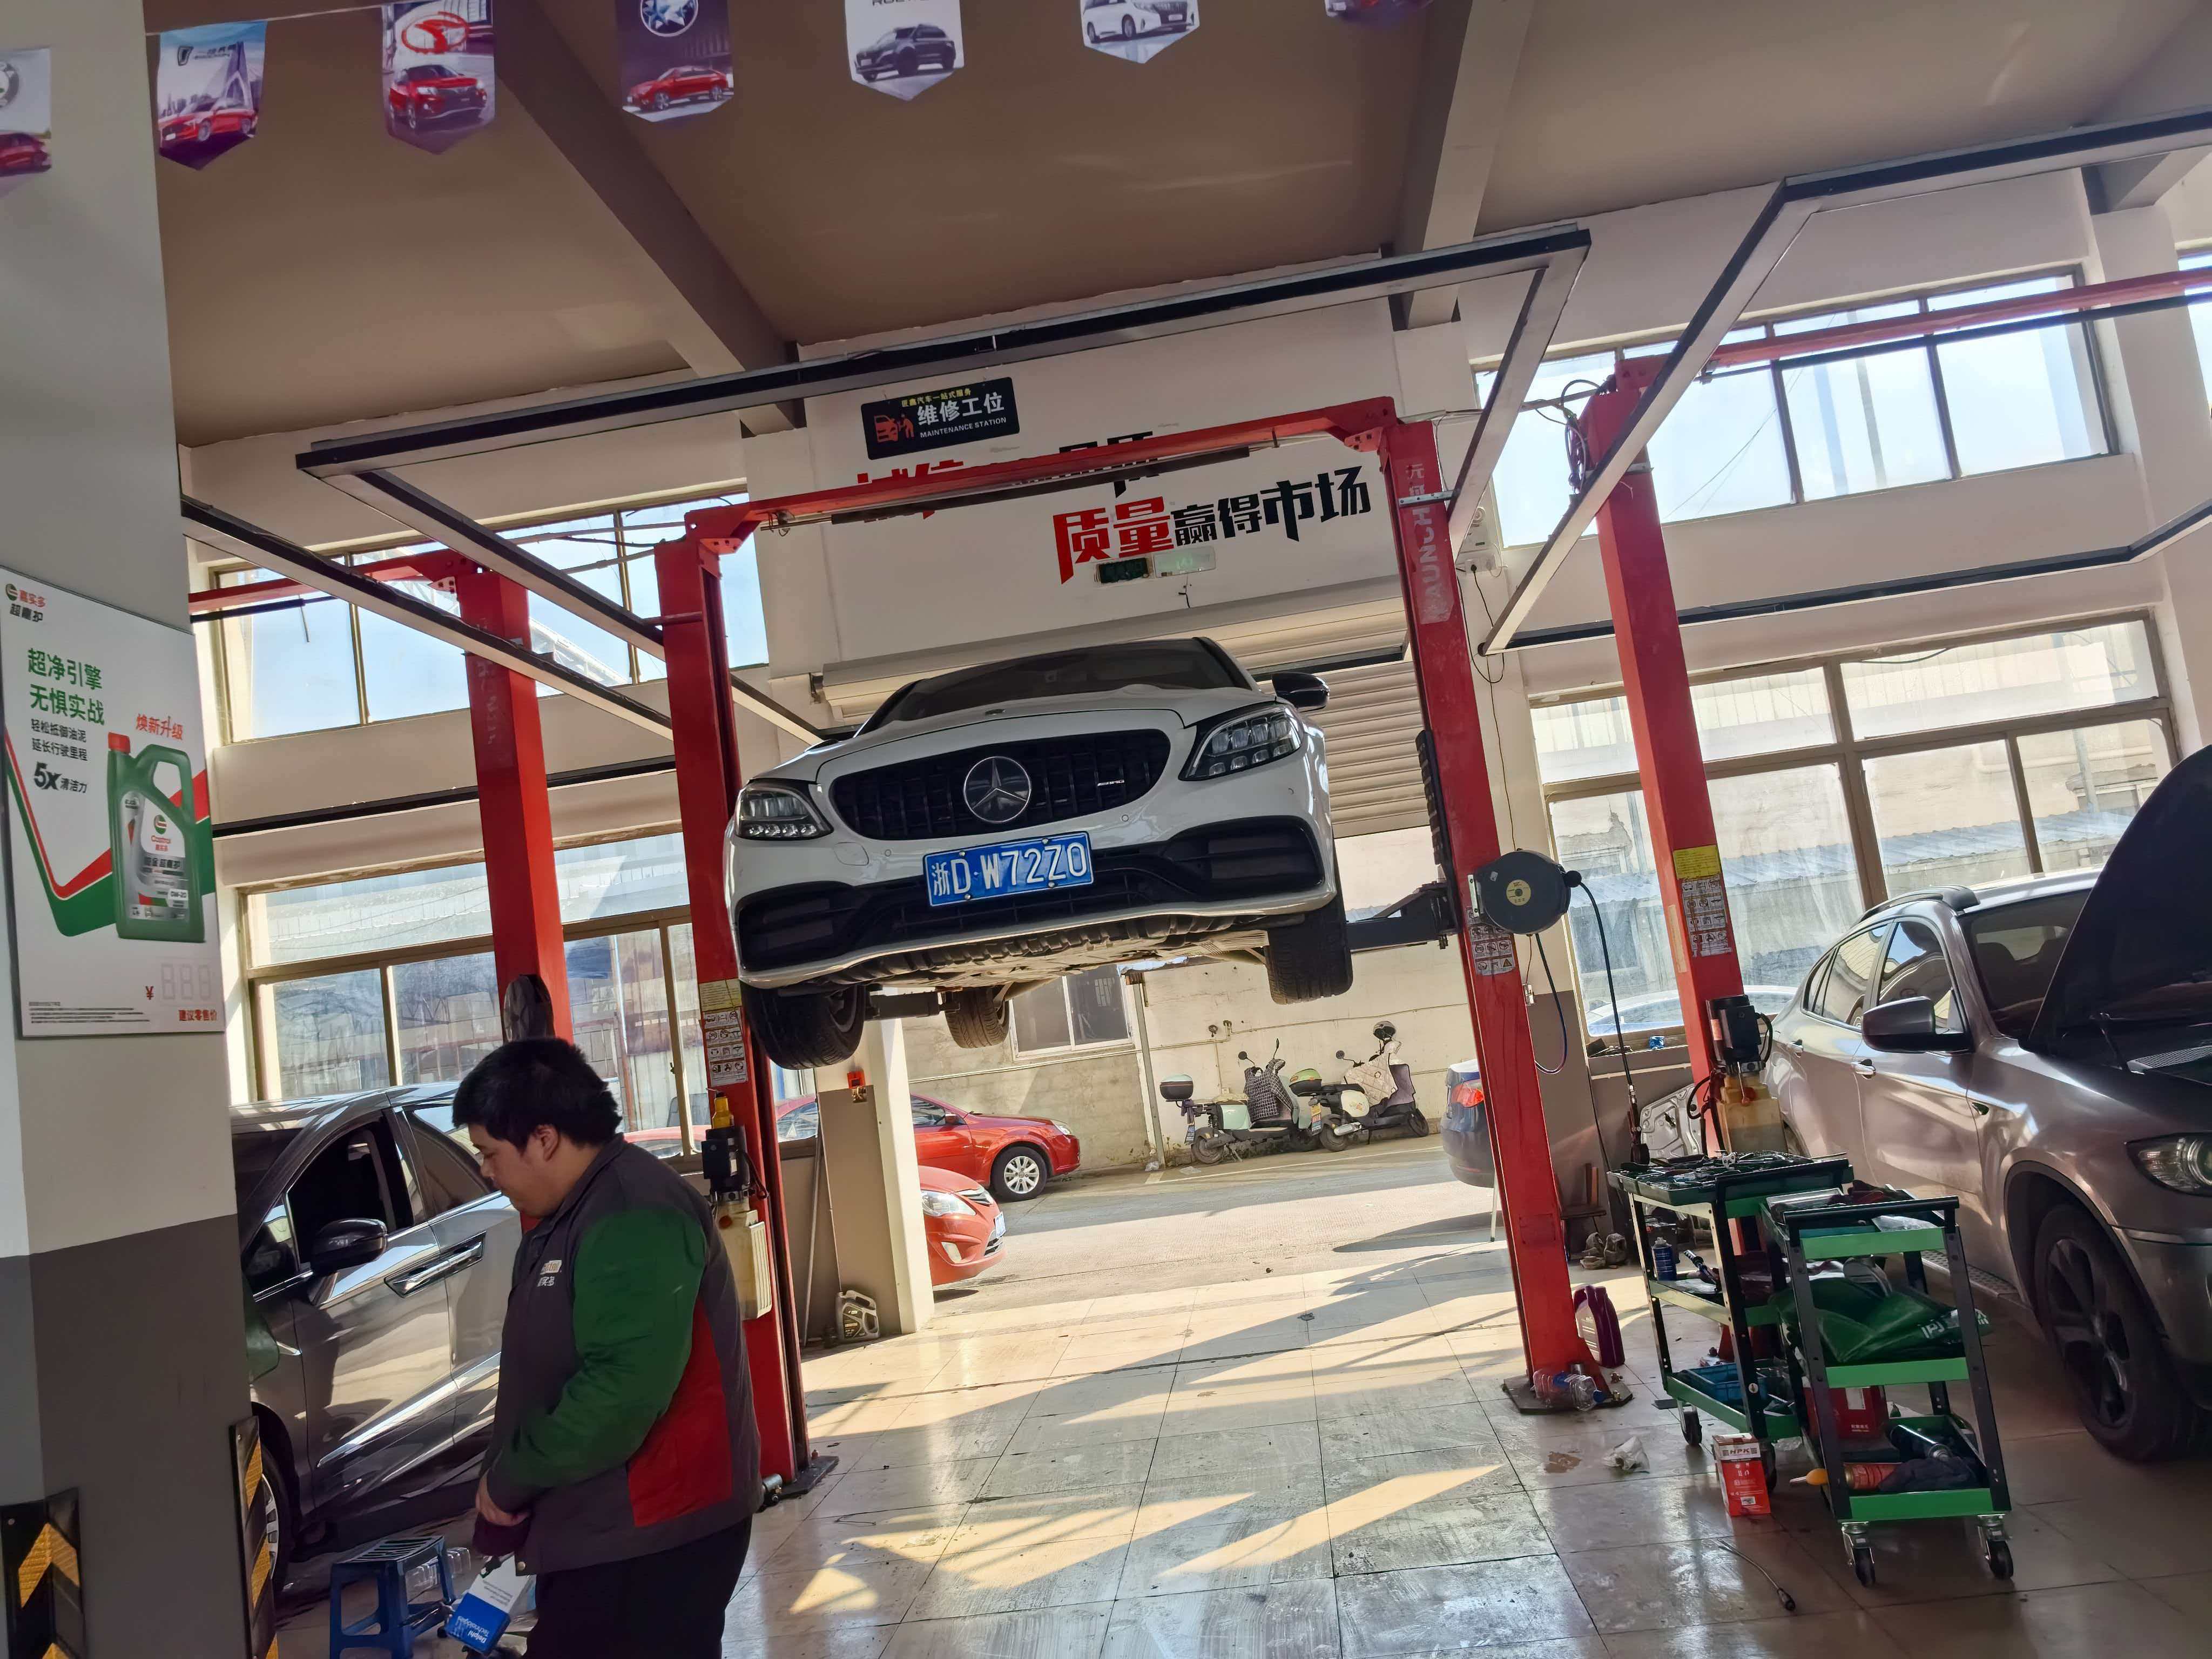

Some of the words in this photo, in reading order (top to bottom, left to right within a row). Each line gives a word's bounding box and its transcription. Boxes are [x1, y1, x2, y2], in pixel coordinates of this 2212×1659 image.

[917, 392, 1005, 426] 维修工位
[920, 423, 973, 439] MAINTENANCE
[975, 416, 1007, 428] STATION
[1053, 466, 1371, 584] 质量赢得市场
[28, 648, 103, 690] 超净引擎
[30, 684, 105, 725] 无惧实战
[31, 718, 86, 743] 轻松抵御油泥
[136, 712, 184, 740] 焕新升级
[32, 738, 87, 761] 延长行驶里程
[60, 778, 87, 793] 清洁力
[178, 1009, 217, 1021] 建议零售价
[468, 1630, 487, 1643] Delphi
